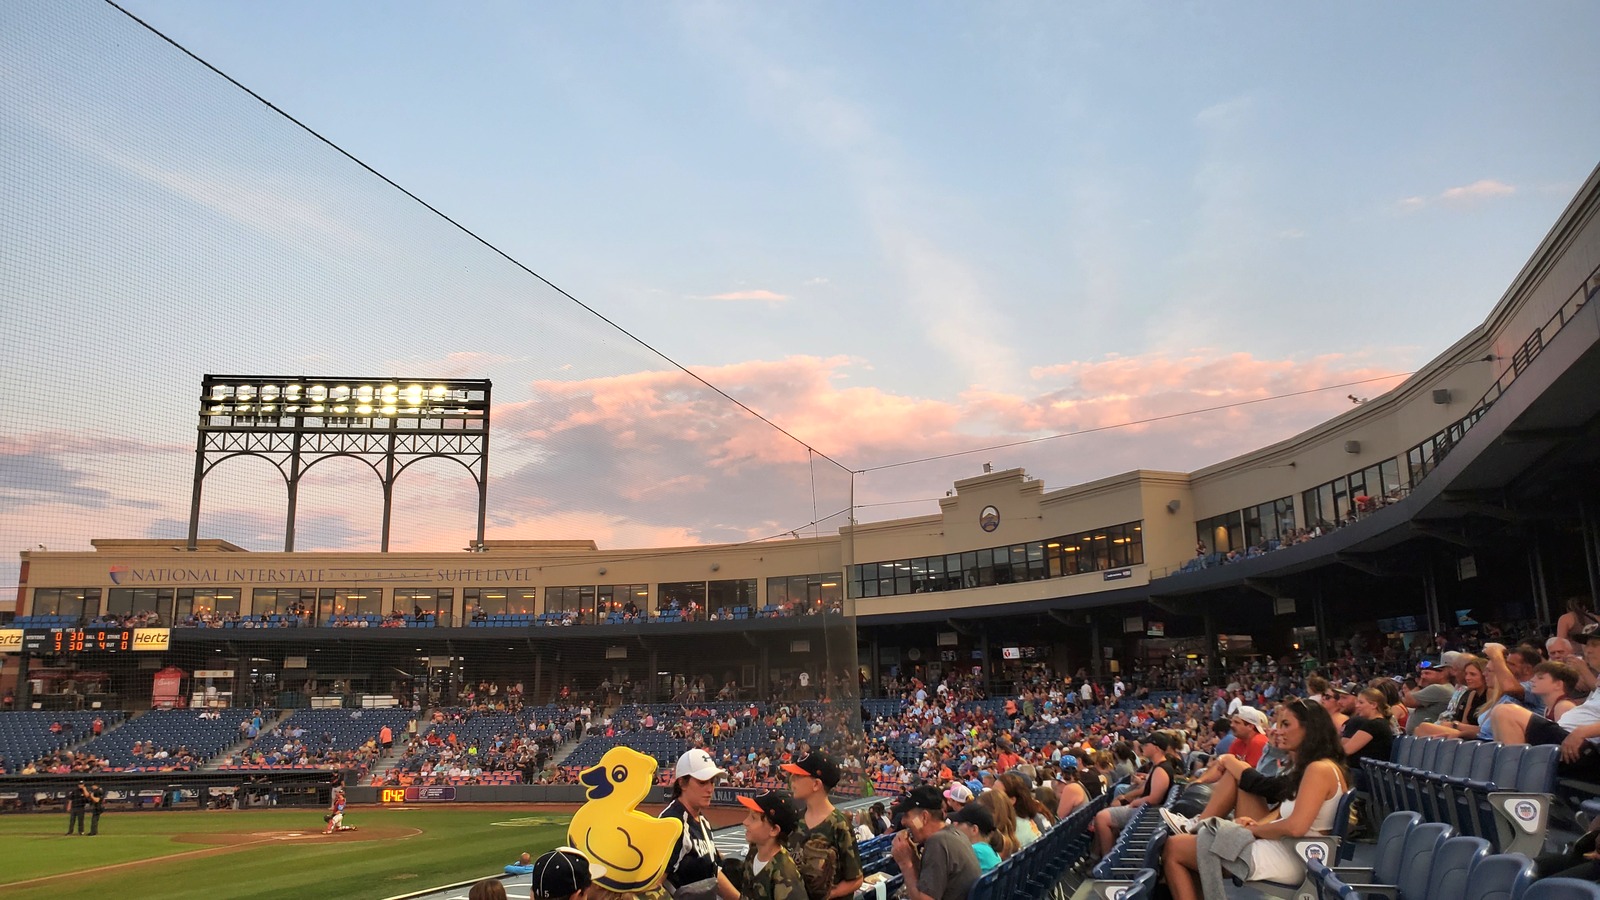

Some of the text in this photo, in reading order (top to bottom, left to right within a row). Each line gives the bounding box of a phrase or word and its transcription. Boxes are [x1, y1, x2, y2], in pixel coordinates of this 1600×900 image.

[131, 568, 220, 581] NATIONAL
[226, 568, 325, 582] INTERSTATE
[437, 568, 482, 581] SUITE
[487, 568, 531, 581] LEVEL
[98, 632, 105, 641] 0
[122, 632, 129, 641] 0
[134, 633, 169, 643] Hertz
[55, 641, 61, 651] 3
[544, 890, 550, 898] 5
